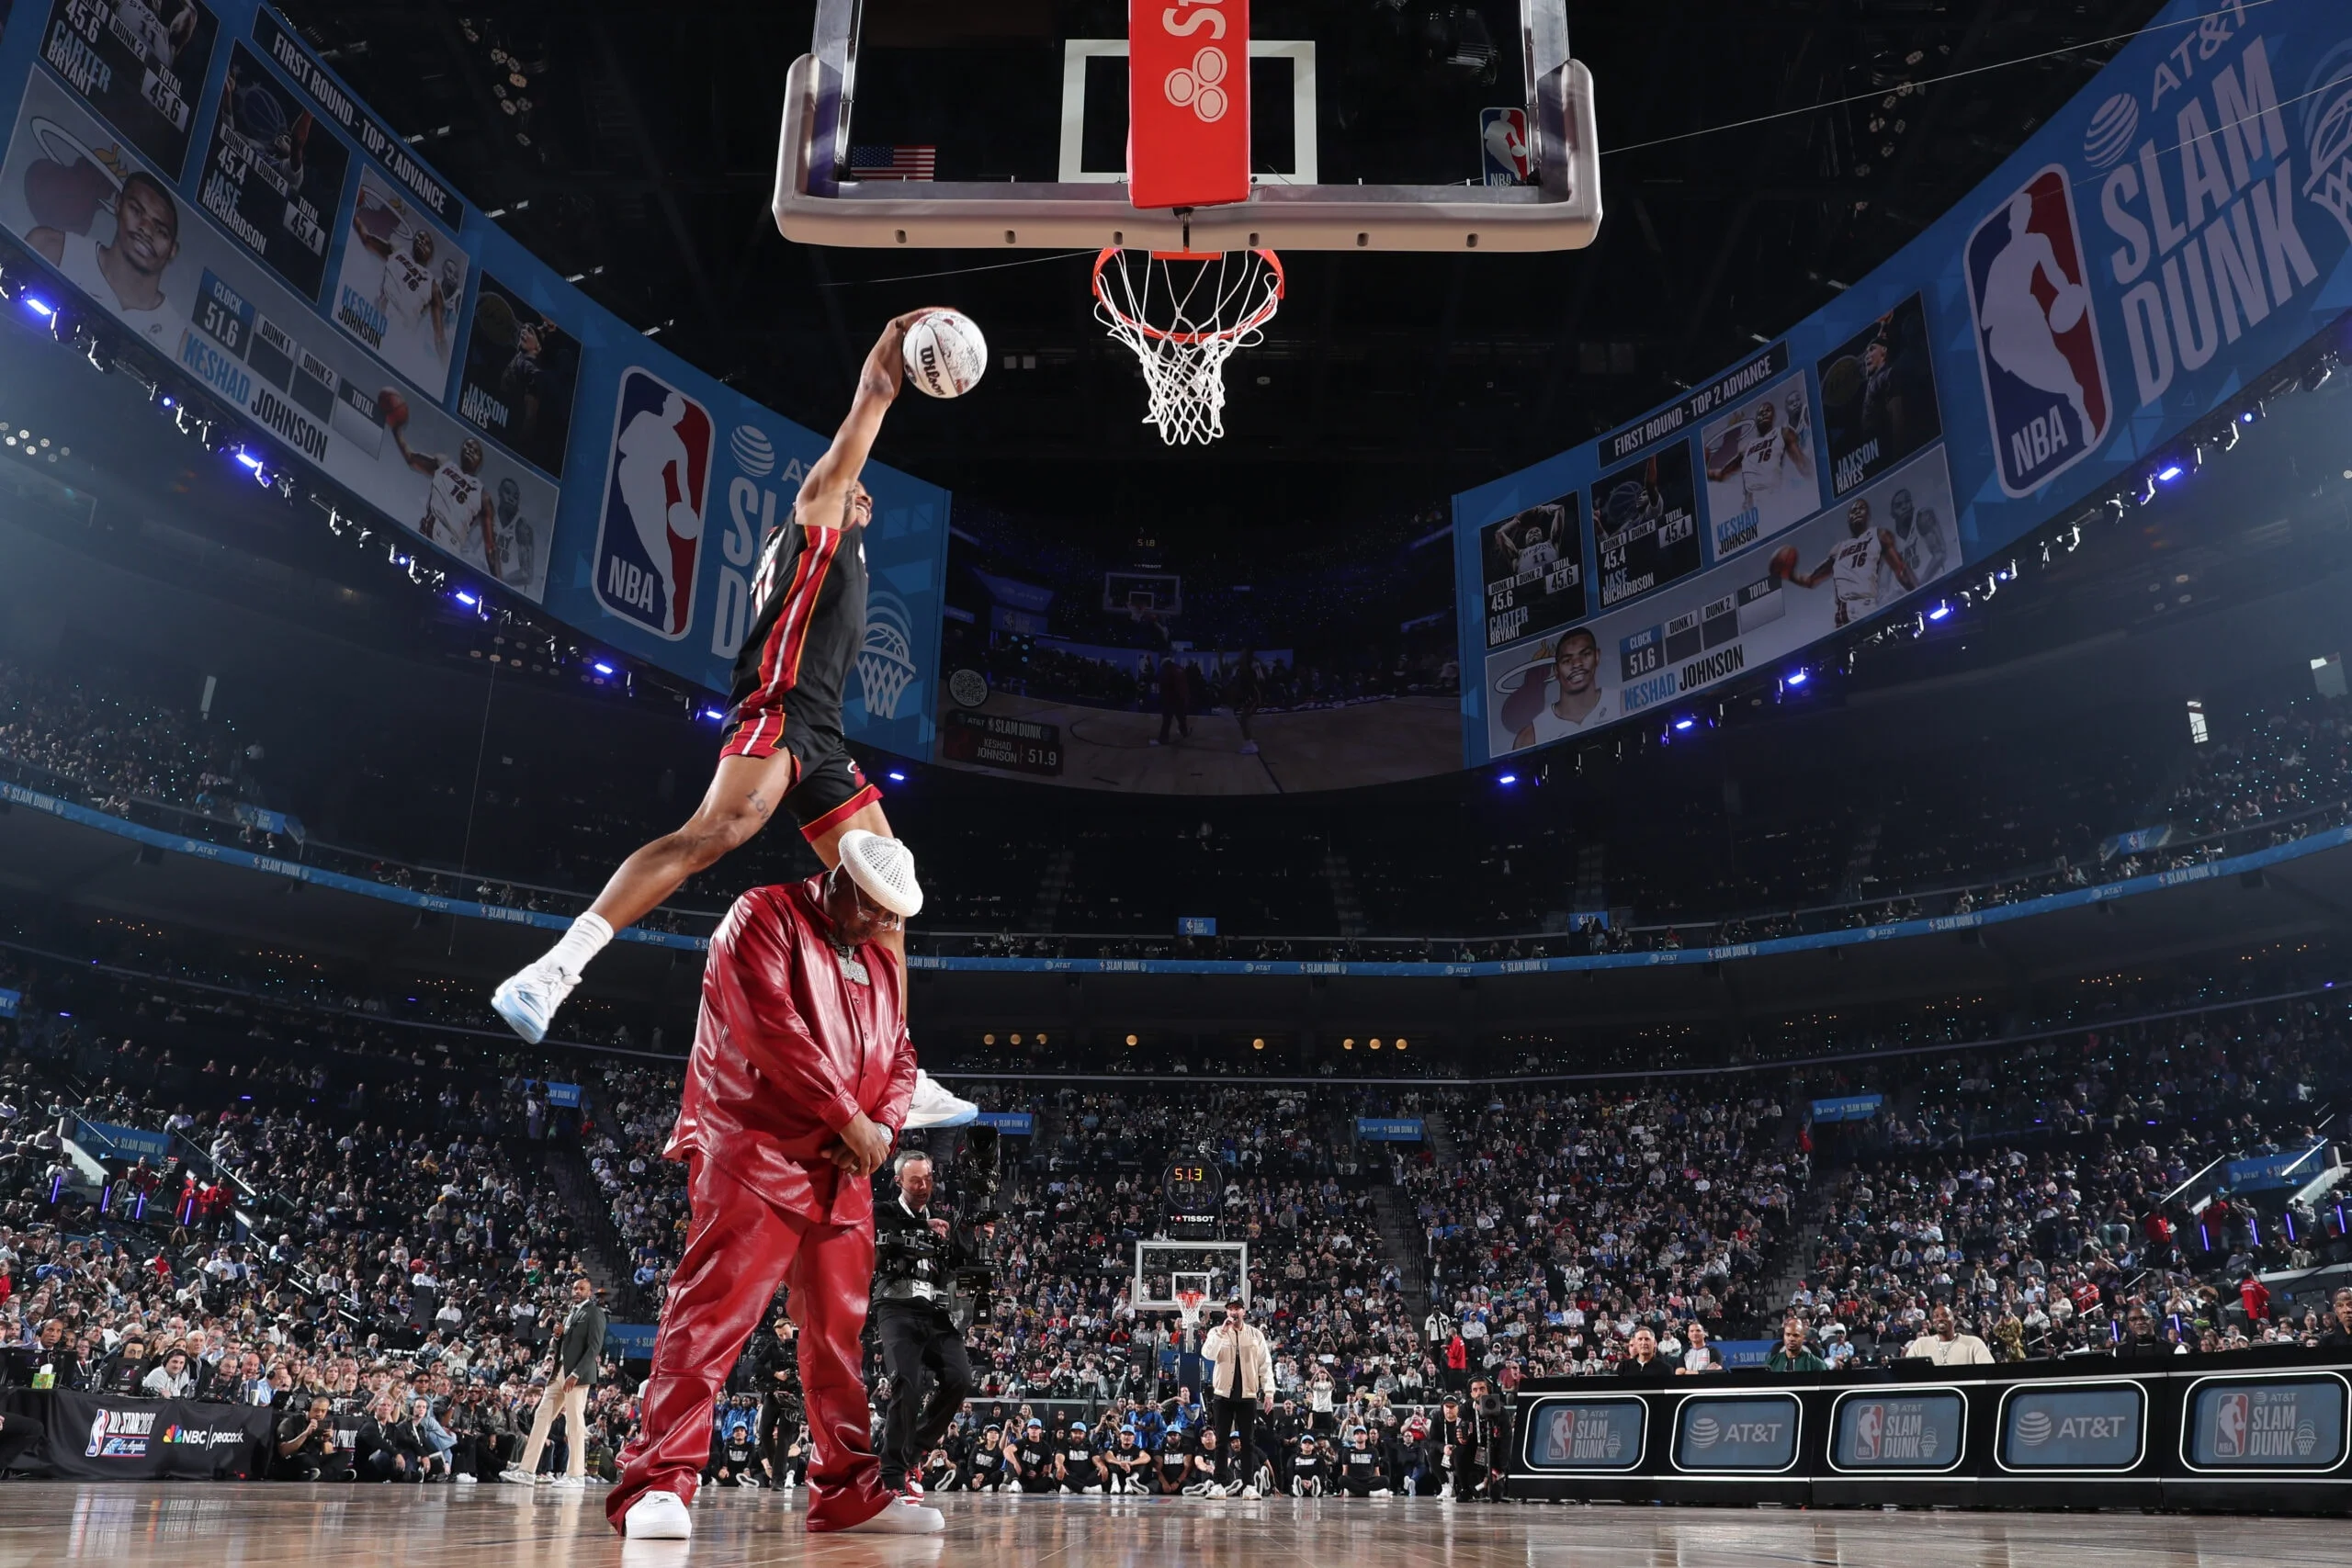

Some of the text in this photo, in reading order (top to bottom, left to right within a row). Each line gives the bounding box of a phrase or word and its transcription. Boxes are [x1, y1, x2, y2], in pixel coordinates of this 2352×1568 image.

[65, 0, 100, 43] 45.6
[113, 18, 144, 58] DUNK 2
[51, 19, 112, 94] CARTER
[2153, 0, 2247, 111] AT&T
[47, 40, 93, 96] BRYANT
[158, 63, 183, 96] TOTAL
[150, 80, 182, 122] 45.6
[273, 31, 447, 215] FIRST ROUND TOP 2 ADVANCE
[224, 128, 245, 155] DUNK
[217, 145, 247, 186] 45.4
[2101, 35, 2289, 283] SLAM
[258, 162, 286, 193] DUNK 2
[1490, 173, 1513, 186] NBA
[208, 169, 242, 209] JASE
[202, 179, 267, 255] RICHARDSON
[299, 196, 319, 225] TOTAL
[291, 212, 317, 249] 45.4
[2120, 157, 2319, 407] DUNK
[214, 281, 243, 315] CLOCK
[342, 284, 388, 337] KESHAD
[205, 301, 239, 347] 51.6
[338, 305, 382, 350] JOHNSON
[262, 320, 291, 354] DUNK 1
[304, 354, 334, 387] DUNK 2
[921, 344, 945, 396] Wilson
[184, 332, 329, 463] KESHAD JOHNSON
[353, 389, 375, 419] TOTAL
[465, 382, 509, 428] JAXSON
[1614, 355, 1772, 457] FIRST ROUND TOP 2 ADVANCE
[461, 391, 488, 429] HAYES
[1747, 436, 1777, 457] HEAT
[2011, 404, 2069, 477] NBA
[1758, 447, 1772, 465] 16
[1837, 437, 1880, 476] JAXSON
[442, 468, 478, 493] HEAT
[1837, 466, 1864, 495] HAYES
[450, 485, 469, 504] 16
[1665, 507, 1682, 524] TOTAL
[1717, 507, 1759, 542] KESHAD
[1631, 521, 1654, 539] DUNK 2
[1665, 525, 1687, 544] 45.4
[1718, 525, 1758, 556] JOHNSON
[1603, 536, 1620, 551] DUNK
[1840, 537, 1872, 559] HEAT
[1553, 557, 1571, 571] TOTAL
[1604, 547, 1626, 570] 45.4
[1851, 551, 1867, 569] 16
[607, 554, 654, 615] NBA
[1491, 580, 1507, 593] DUNK
[1520, 568, 1541, 584] DUNK 2
[1552, 569, 1574, 592] 45.6
[1605, 567, 1628, 591] JASE
[1603, 571, 1655, 606] RICHARDSON
[1748, 579, 1770, 600] TOTAL
[1490, 590, 1514, 613] 45.6
[1705, 597, 1731, 618] DUNK 2
[1489, 606, 1529, 632] CARTER
[1669, 614, 1693, 634] DUNK 1
[1490, 625, 1521, 646] BRYANT
[1630, 629, 1652, 649] CLOCK
[1629, 649, 1656, 676] 51.6
[1624, 643, 1744, 712] KESHAD JOHNSON
[967, 717, 985, 727] AT&T
[995, 718, 1041, 739] SLAM DUNK
[984, 739, 1012, 750] KESHAD
[978, 748, 1017, 763] JOHNSON
[1028, 749, 1057, 766] 51.9
[11, 787, 55, 811] SLAM DUNK
[197, 844, 219, 858] AT&T
[261, 858, 300, 878] SLAM DUNK
[2166, 865, 2210, 886] SLAM DUNK
[2104, 885, 2123, 897] AT&T
[429, 899, 449, 909] AT&T
[489, 906, 525, 924] SLAM DUNK
[1936, 916, 1974, 931] SLAM DUNK
[648, 934, 666, 943] AT&T
[1877, 928, 1896, 938] AT&T
[906, 956, 940, 968] SLAM DUNK
[1660, 953, 1678, 962] AT&T
[1715, 945, 1749, 960] SLAM DUNK
[1106, 960, 1139, 972] SLAM DUNK
[1306, 963, 1340, 975] SLAM DUNK
[1507, 960, 1541, 973] SLAM DUNK
[1388, 1125, 1401, 1134] SLAM
[120, 1138, 155, 1154] SLAM DUNK
[1174, 1168, 1202, 1181] 51.3
[2243, 1171, 2259, 1180] AT&T
[1739, 1351, 1755, 1362] SLAM
[1900, 1404, 1924, 1412] AT&T
[2269, 1393, 2297, 1403] AT&T
[1886, 1415, 1922, 1436] SLAM
[2057, 1416, 2125, 1438] AT&T
[2252, 1405, 2297, 1430] SLAM
[182, 1429, 208, 1445] NBC
[209, 1427, 244, 1450] peacock
[1576, 1420, 1608, 1439] SLAM
[1724, 1423, 1782, 1444] AT&T
[1550, 1448, 1562, 1457] NBA
[1574, 1439, 1607, 1459] DUNK
[1857, 1447, 1871, 1456] NBA
[1883, 1437, 1920, 1459] DUNK
[2218, 1442, 2233, 1452] NBA
[2250, 1430, 2295, 1456] DUNK
